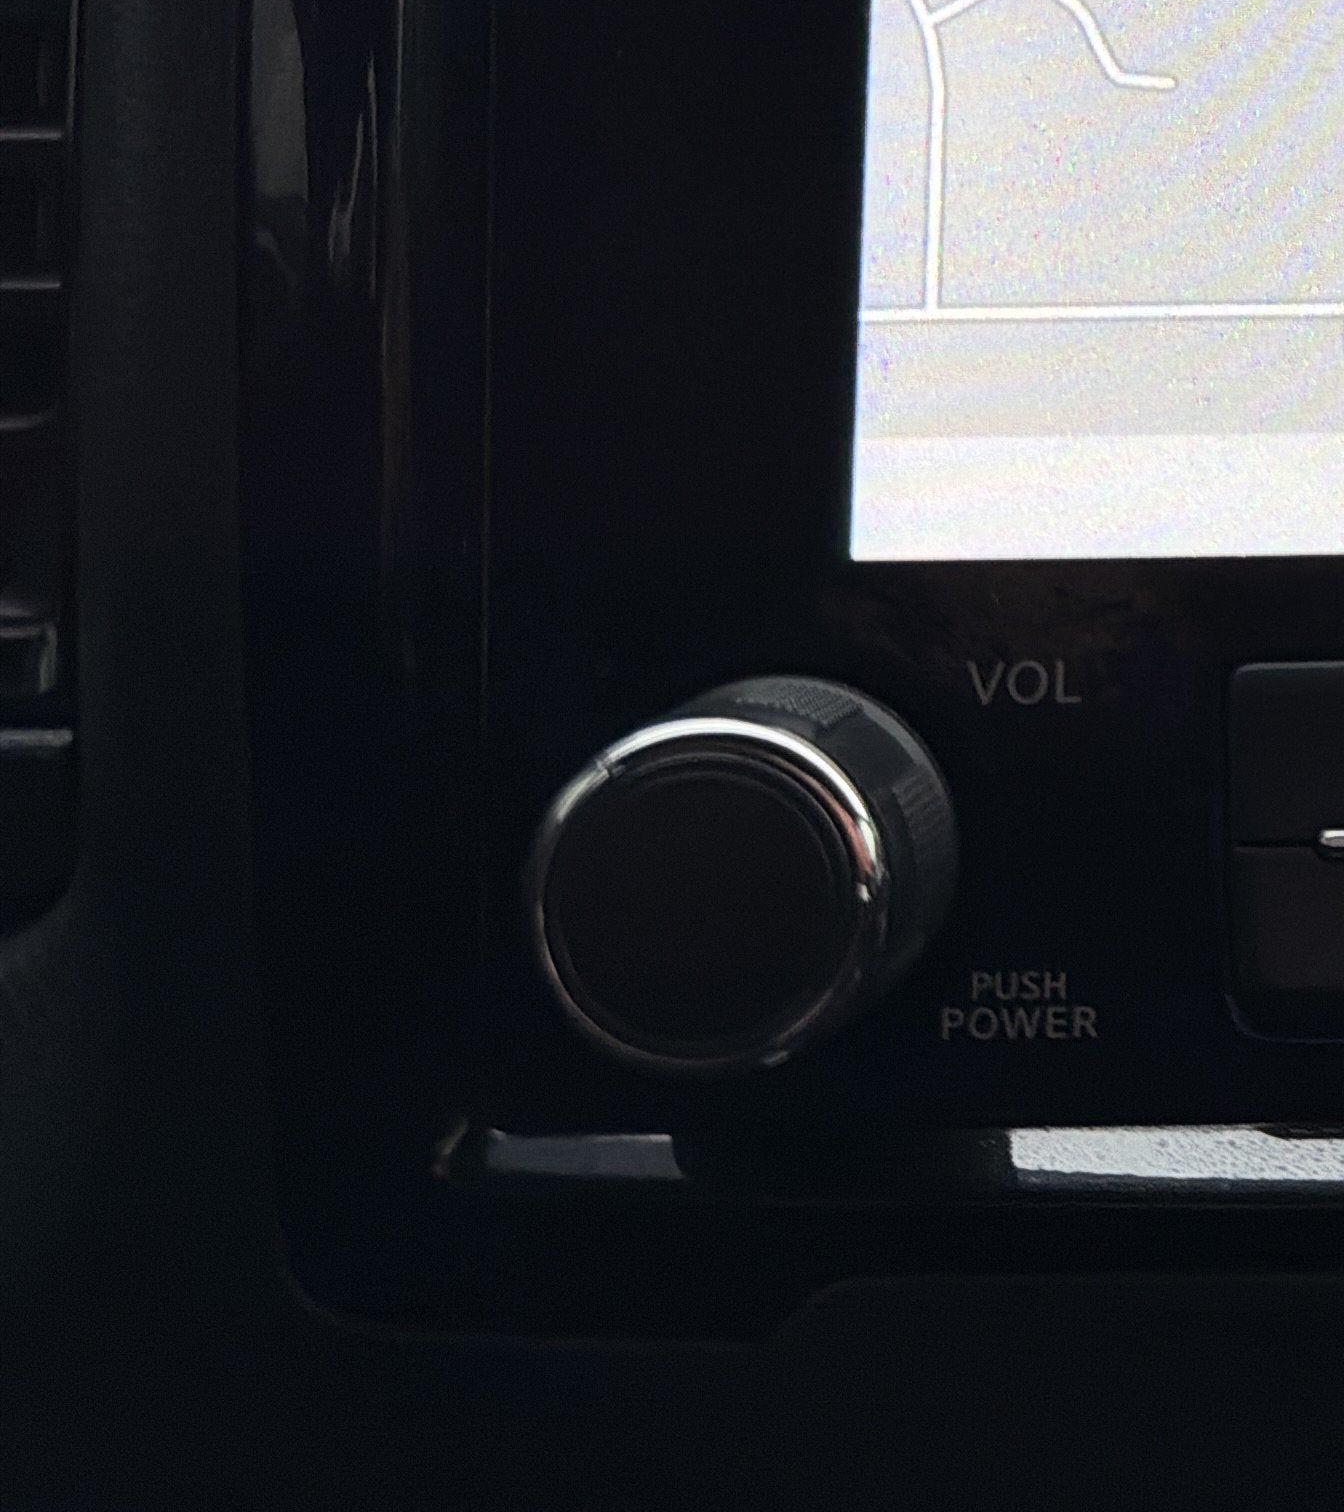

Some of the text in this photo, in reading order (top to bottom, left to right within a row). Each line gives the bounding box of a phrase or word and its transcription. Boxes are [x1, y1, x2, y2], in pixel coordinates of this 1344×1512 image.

[966, 659, 1082, 706] VOL
[970, 971, 1069, 1001] PUSH
[940, 1005, 1099, 1040] POWER
